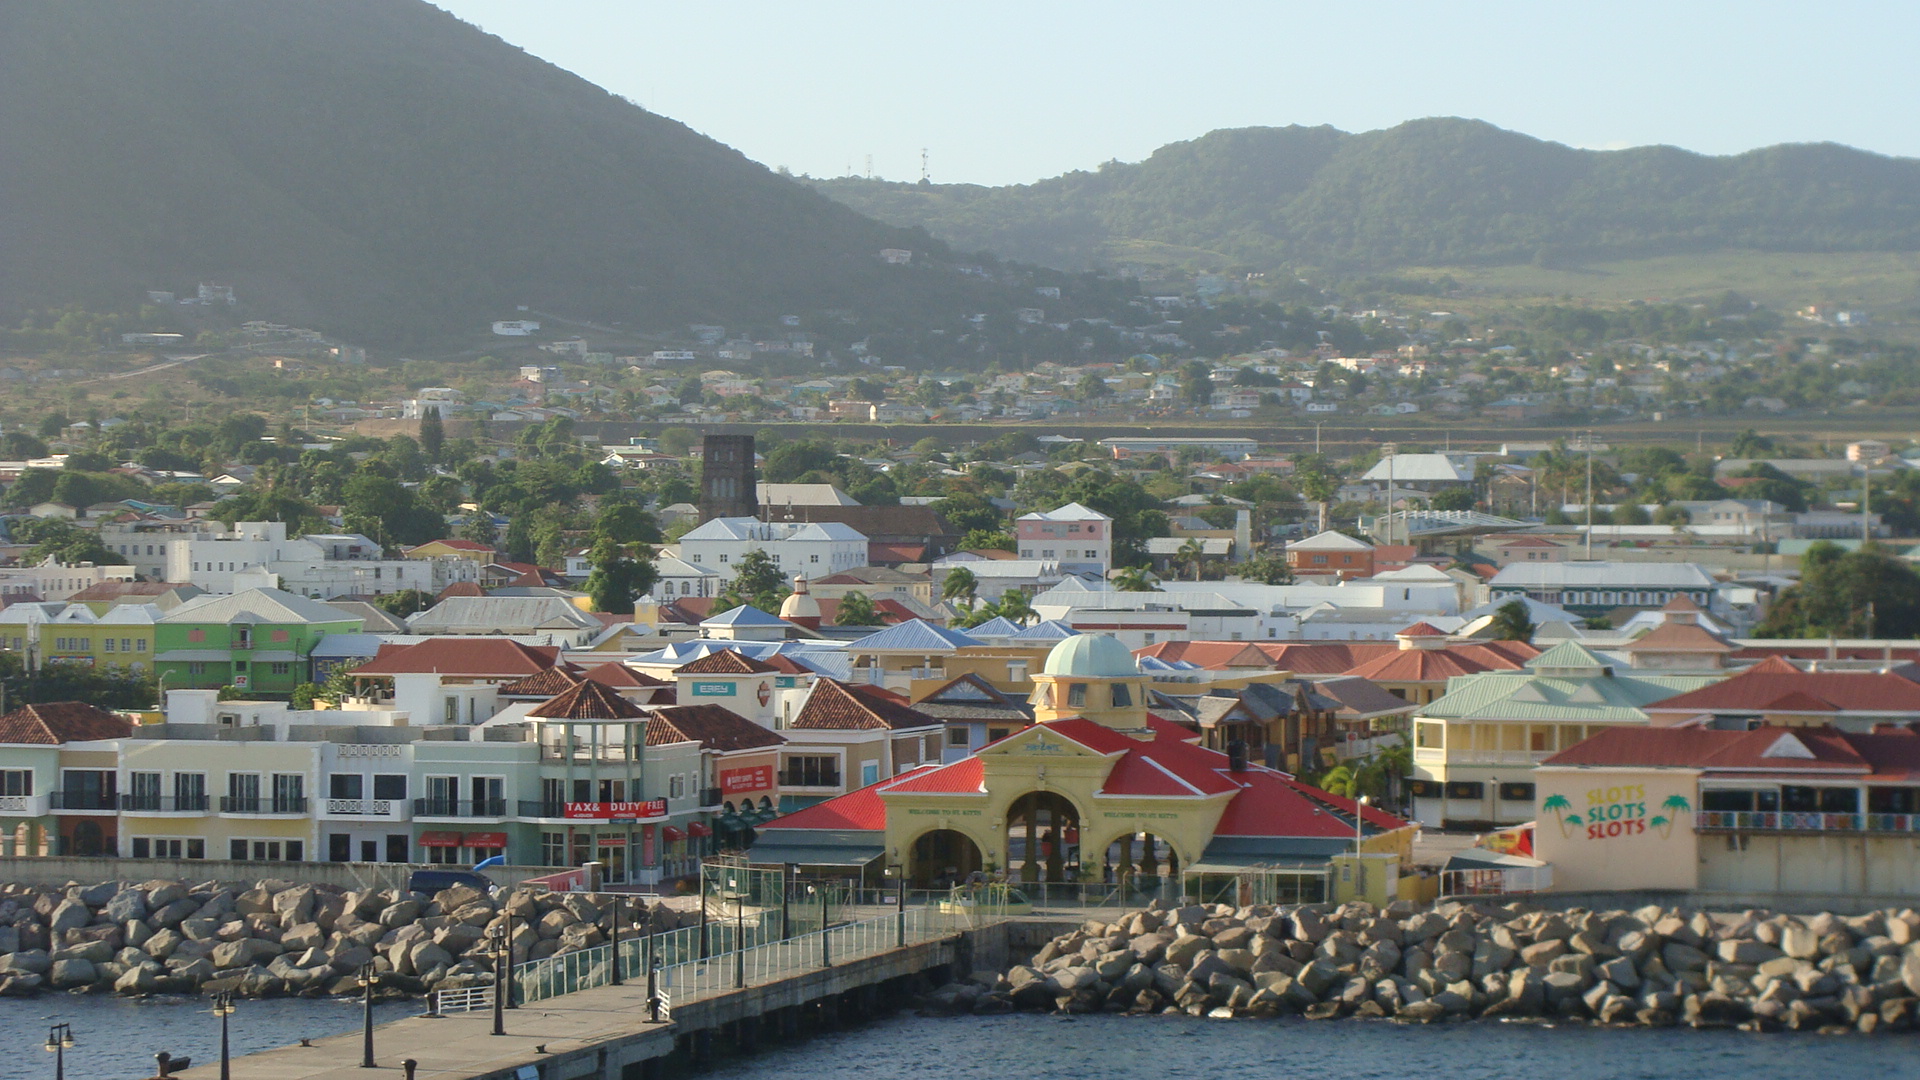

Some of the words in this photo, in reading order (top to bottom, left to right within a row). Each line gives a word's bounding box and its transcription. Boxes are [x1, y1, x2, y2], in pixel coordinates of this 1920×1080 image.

[1587, 784, 1645, 805] SLOTS
[610, 802, 641, 811] DUTY
[647, 800, 664, 810] FREE
[1588, 801, 1646, 822] SLOTS
[1587, 819, 1645, 840] SLOTS
